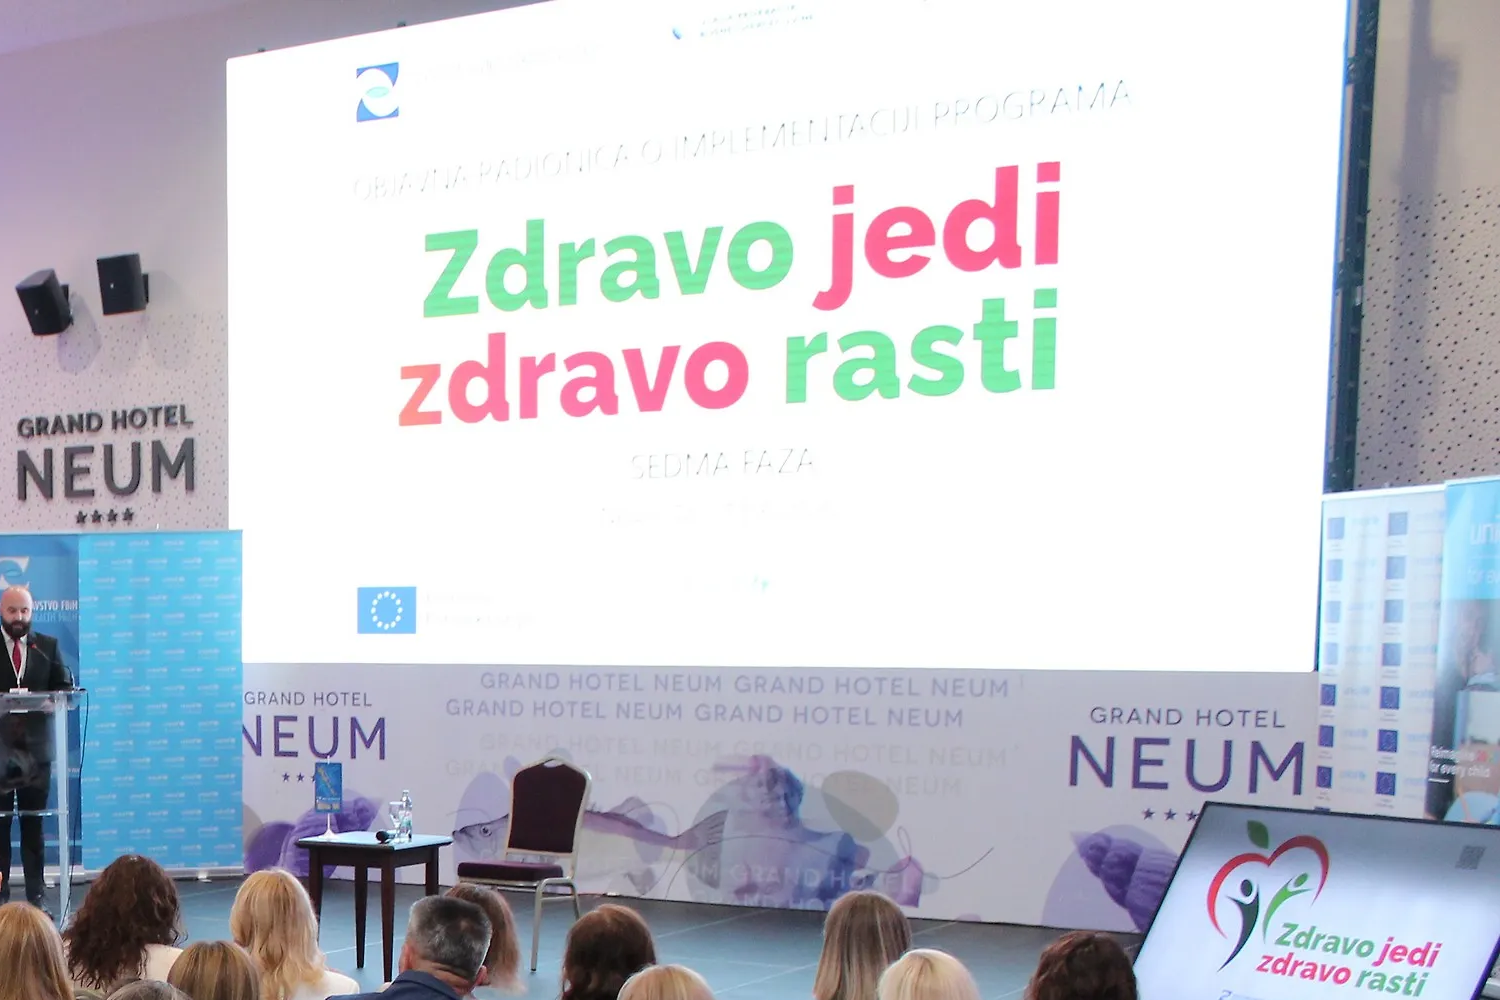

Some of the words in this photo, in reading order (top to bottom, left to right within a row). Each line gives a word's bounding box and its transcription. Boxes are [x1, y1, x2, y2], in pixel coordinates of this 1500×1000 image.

[673, 103, 919, 161] IMPLEMENTACIJI
[934, 79, 1134, 128] PROGRAMA
[422, 219, 793, 318] Zdravo
[811, 161, 1061, 311] jedi
[398, 332, 749, 427] zdravo
[785, 288, 1057, 404] rasti
[17, 412, 103, 438] GRAND
[111, 404, 194, 431] HOTEL
[17, 437, 195, 501] NEUM
[631, 452, 729, 480] SEDMA
[742, 448, 818, 476] FAZA
[244, 691, 305, 705] GRAND
[313, 692, 372, 707] HOTEL
[480, 672, 560, 690] GRAND
[569, 673, 644, 691] HOTEL
[654, 674, 722, 692] NEUM
[734, 675, 824, 694] GRAND
[835, 676, 920, 696] HOTEL
[932, 678, 1009, 697] NEUM
[446, 698, 524, 717] GRAND
[533, 700, 606, 719] HOTEL
[616, 701, 682, 720] NEUM
[694, 703, 783, 723] GRAND
[793, 706, 876, 726] HOTEL
[887, 708, 963, 728] NEUM
[1090, 706, 1183, 726] GRAND
[1196, 709, 1285, 728] HOTEL
[242, 715, 386, 760] NEUM
[1068, 735, 1305, 795] NEUM
[1274, 921, 1375, 958] Zdravo
[1372, 936, 1443, 968] jedi
[1255, 952, 1352, 985] zdravo
[1354, 967, 1429, 998] rasti
